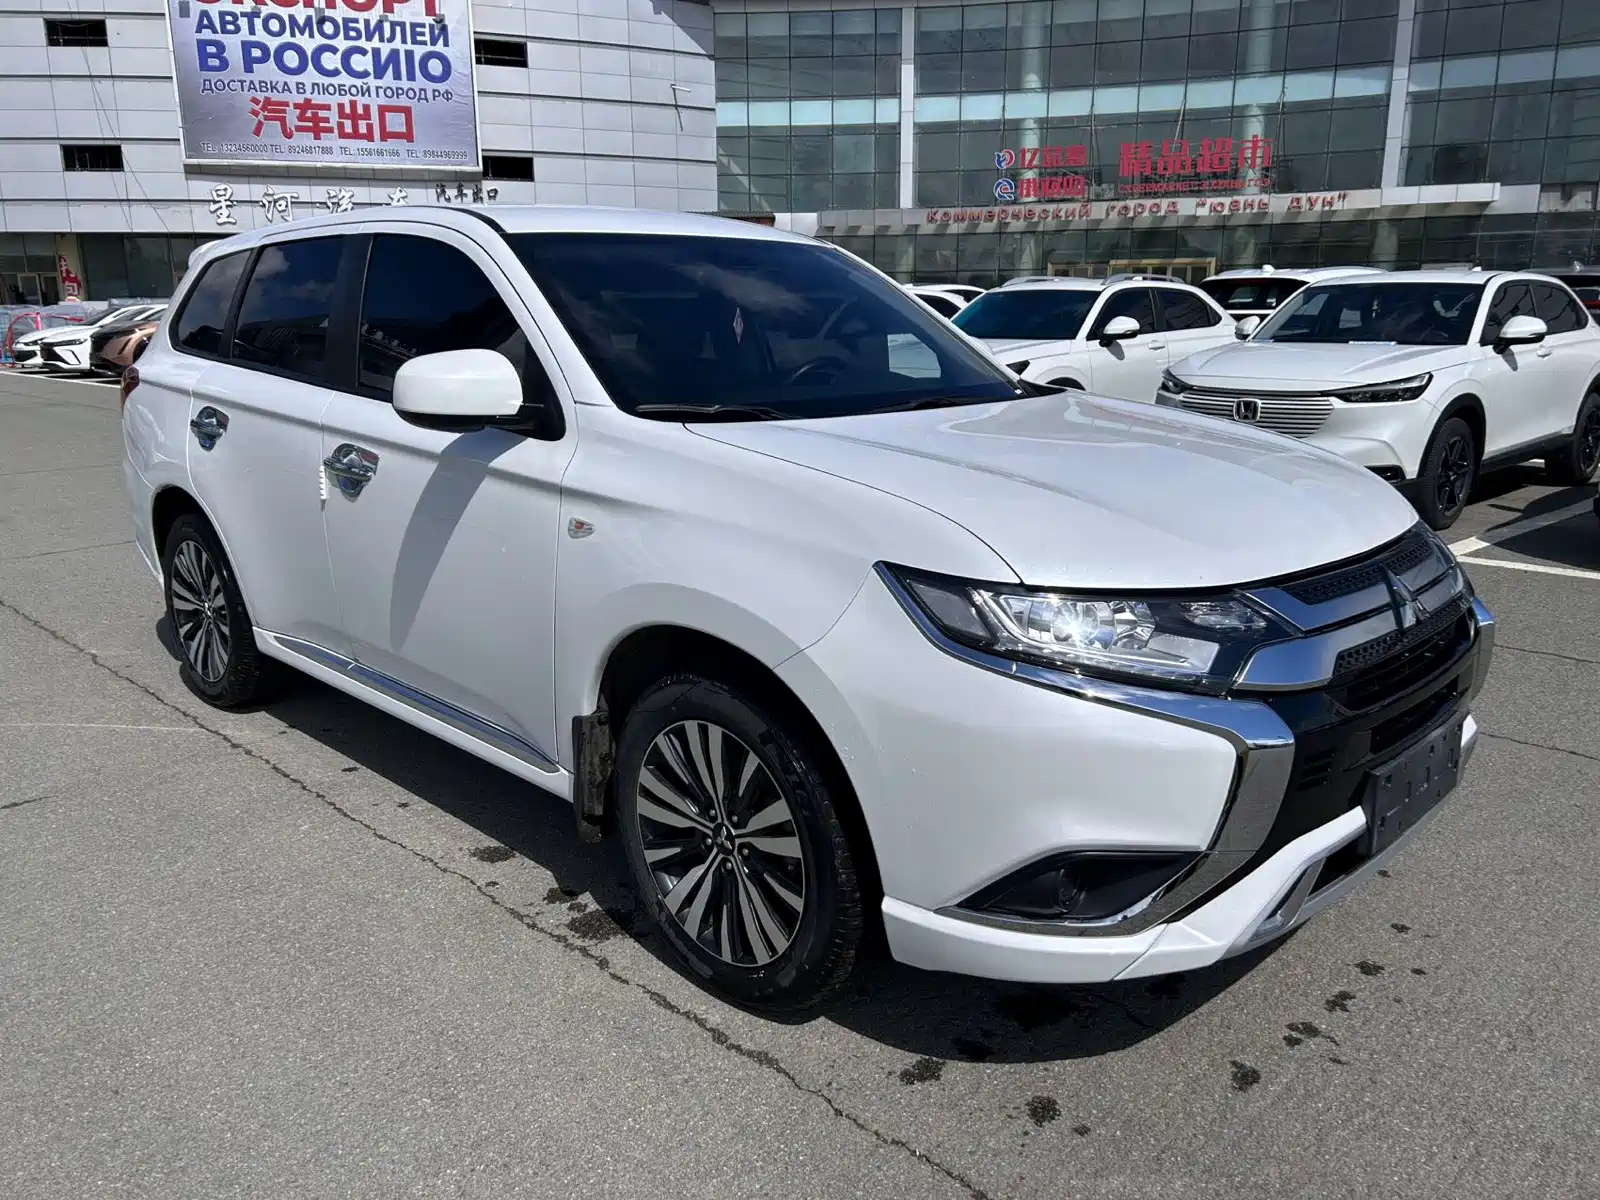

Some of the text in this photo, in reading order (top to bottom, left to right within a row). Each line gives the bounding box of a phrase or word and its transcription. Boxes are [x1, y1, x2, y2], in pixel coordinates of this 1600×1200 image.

[195, 9, 450, 48] АВТОМОБИЛЕЙ
[197, 39, 452, 84] В РОССИЮ
[201, 79, 453, 103] ДОСТАВКА В ЛЮБОЙ ГОРОД РФ
[248, 96, 415, 143] 汽车出口
[1119, 135, 1275, 177] 精品超市
